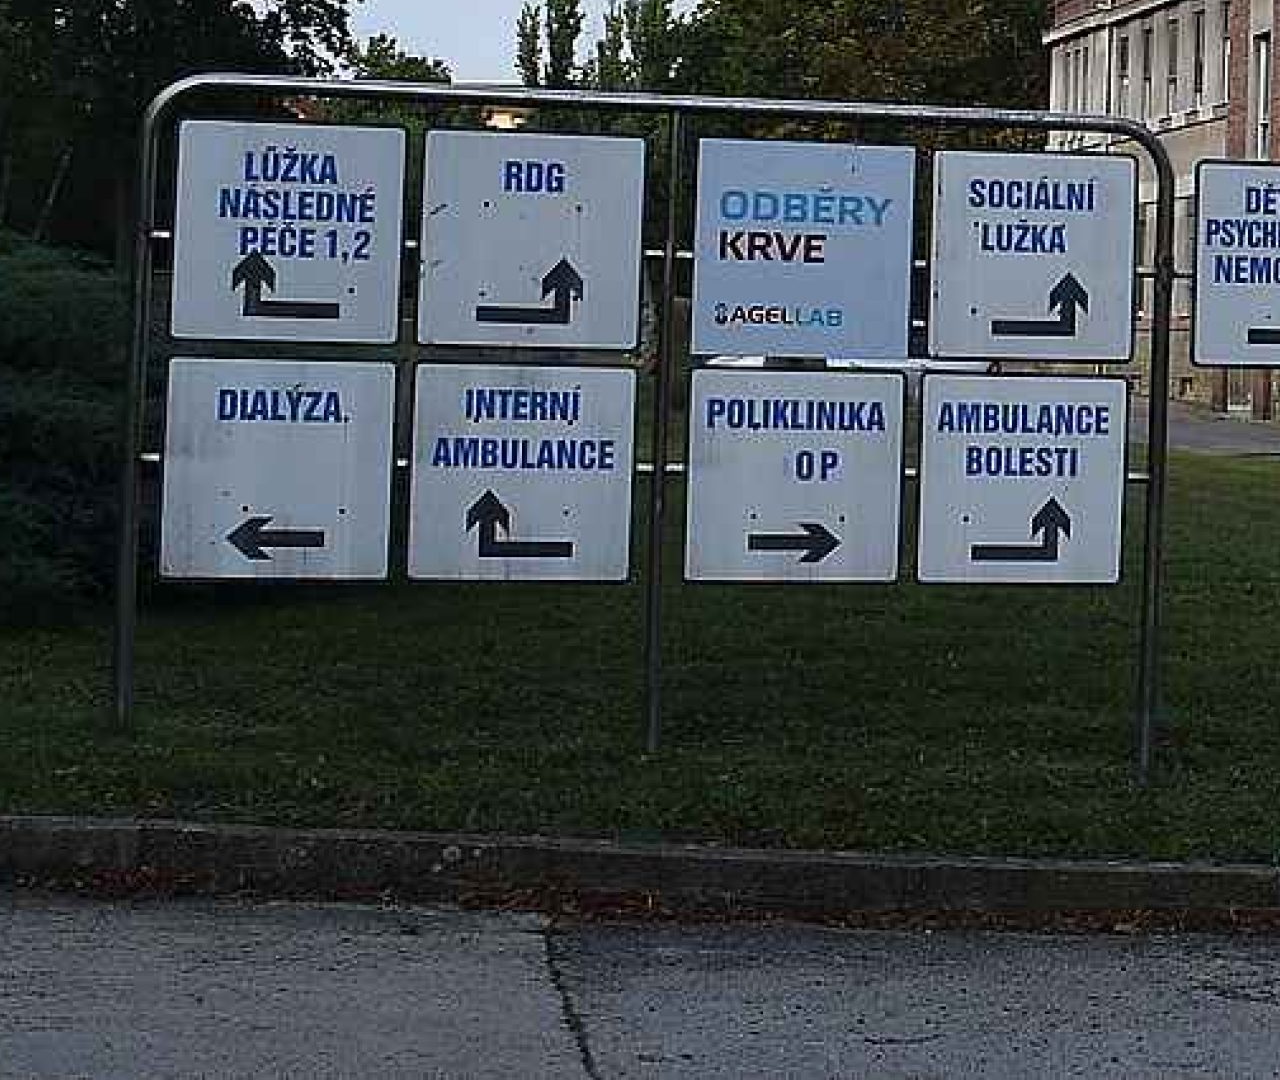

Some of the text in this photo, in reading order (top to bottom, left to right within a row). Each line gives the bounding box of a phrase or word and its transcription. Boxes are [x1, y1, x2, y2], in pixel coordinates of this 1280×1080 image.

[244, 145, 338, 185] LŮŽKA
[503, 160, 564, 192] RDG
[219, 184, 376, 222] NÁSLEDNÉ
[720, 185, 893, 227] ODBĚRY
[968, 176, 1096, 210] SOCIÁLNÍ
[719, 230, 827, 264] KRVE
[219, 384, 343, 421] DIALÝZA
[465, 385, 581, 422] INTERNÍ
[707, 399, 886, 431] POLIKLINIKA
[937, 401, 1109, 434] AMBULANCE
[432, 436, 615, 470] AMBULANCE
[965, 447, 1079, 477] BOLESTI
